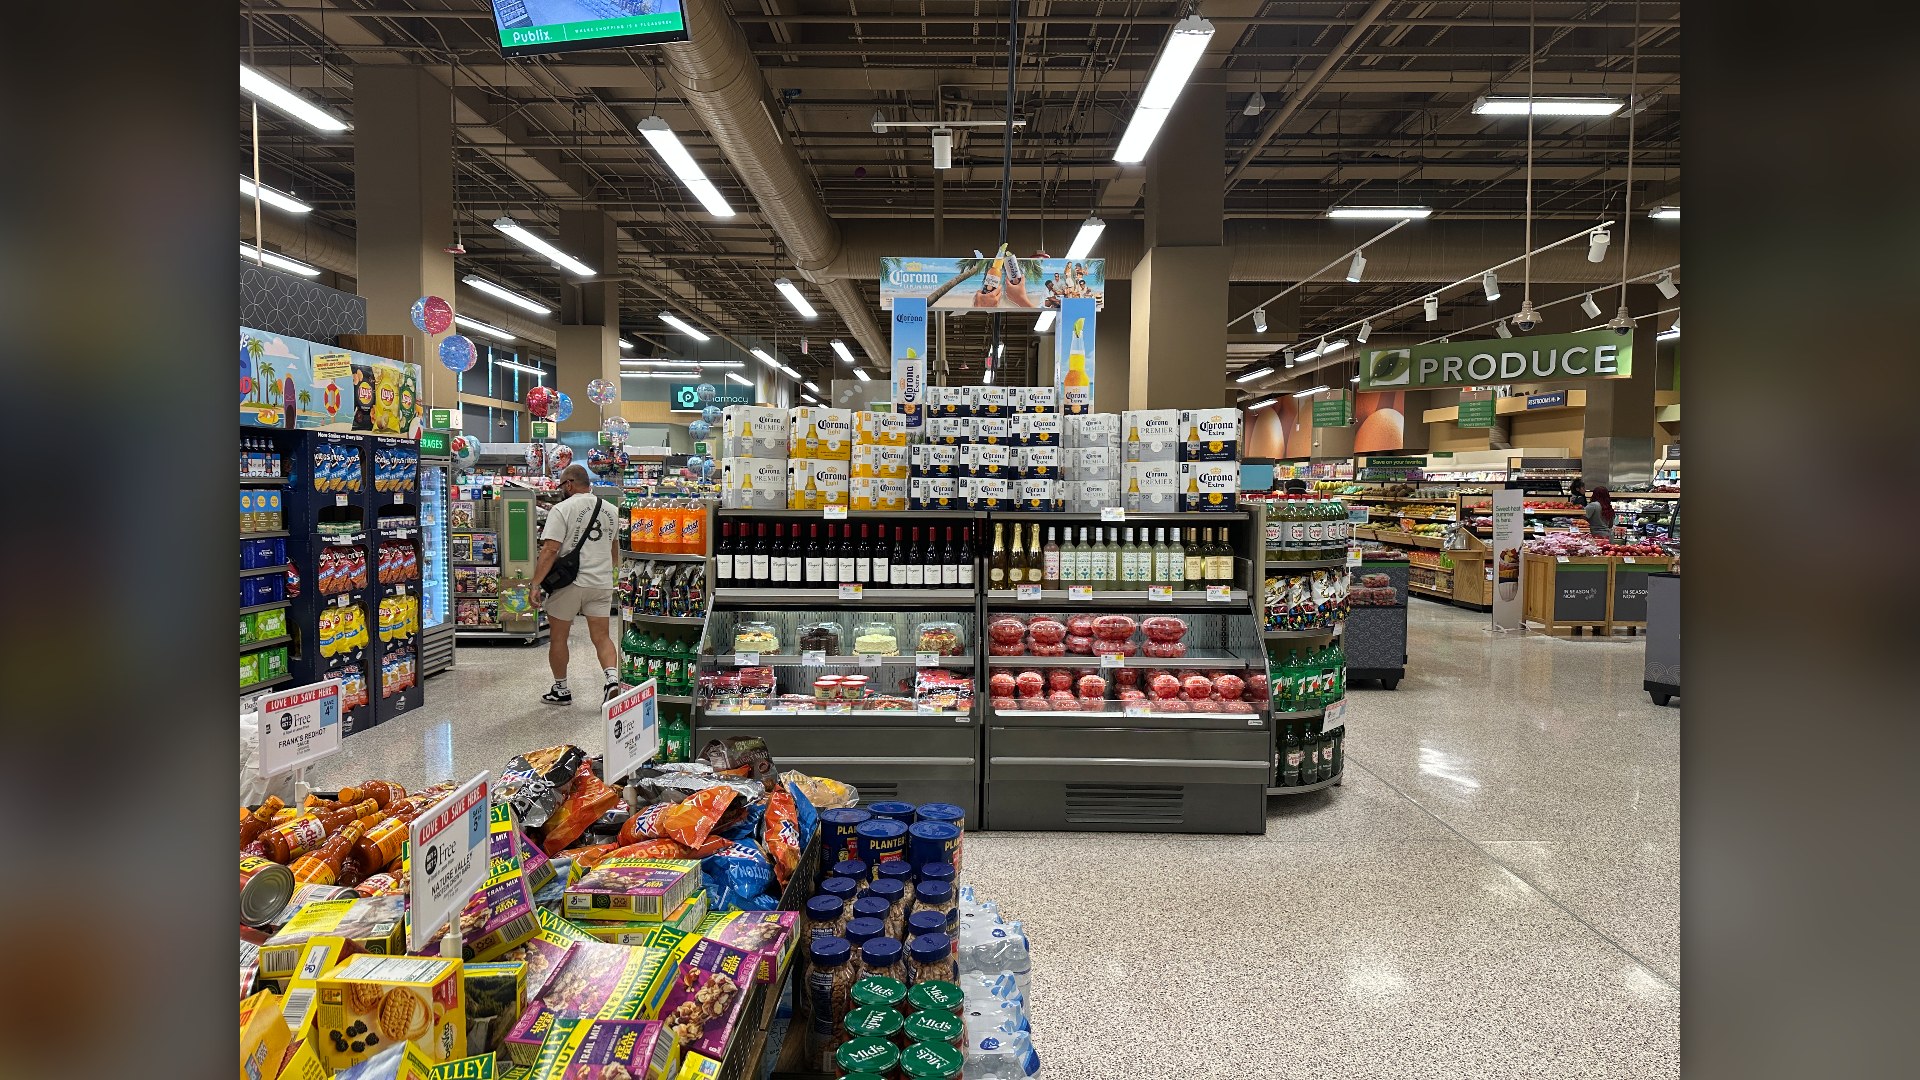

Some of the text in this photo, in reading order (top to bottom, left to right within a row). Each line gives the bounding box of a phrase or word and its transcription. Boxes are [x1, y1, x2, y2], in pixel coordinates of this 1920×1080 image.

[513, 29, 549, 43] Publix
[890, 270, 938, 286] Corona
[896, 313, 922, 323] Corona
[1419, 344, 1618, 384] PRODUCE
[904, 366, 915, 402] Corona
[358, 388, 372, 398] Lay's
[381, 388, 395, 400] Lay's
[712, 394, 749, 404] armacy
[818, 420, 849, 430] Corona
[1200, 420, 1233, 432] Corona
[816, 472, 847, 482] Corona
[1199, 472, 1233, 483] Corona
[271, 687, 334, 710] LOVE TO SAVE HERE.
[612, 705, 623, 716] LOVE
[624, 700, 629, 709] TO
[293, 714, 311, 727] Free
[278, 736, 304, 749] FRANK'S
[422, 789, 482, 842] LOVE TO SAVE HERE.
[472, 805, 482, 818] SAVE
[496, 833, 507, 842] MIX
[438, 840, 456, 865] Free
[432, 870, 453, 895] NATURE
[454, 851, 473, 875] VALLEY
[487, 878, 518, 897] TRAIL MIX
[690, 940, 708, 966] TRAIL MIX
[722, 956, 734, 971] REAL
[728, 955, 741, 975] FRUIT
[864, 982, 894, 996] Mid's
[866, 1011, 887, 1029] Mid's
[919, 1017, 952, 1030] Mid's
[579, 1024, 602, 1064] TRAIL MIX
[615, 1034, 630, 1058] REAL
[621, 1031, 637, 1060] FRUIT
[848, 1045, 885, 1060] Mid's
[431, 1057, 488, 1080] ALLEY
